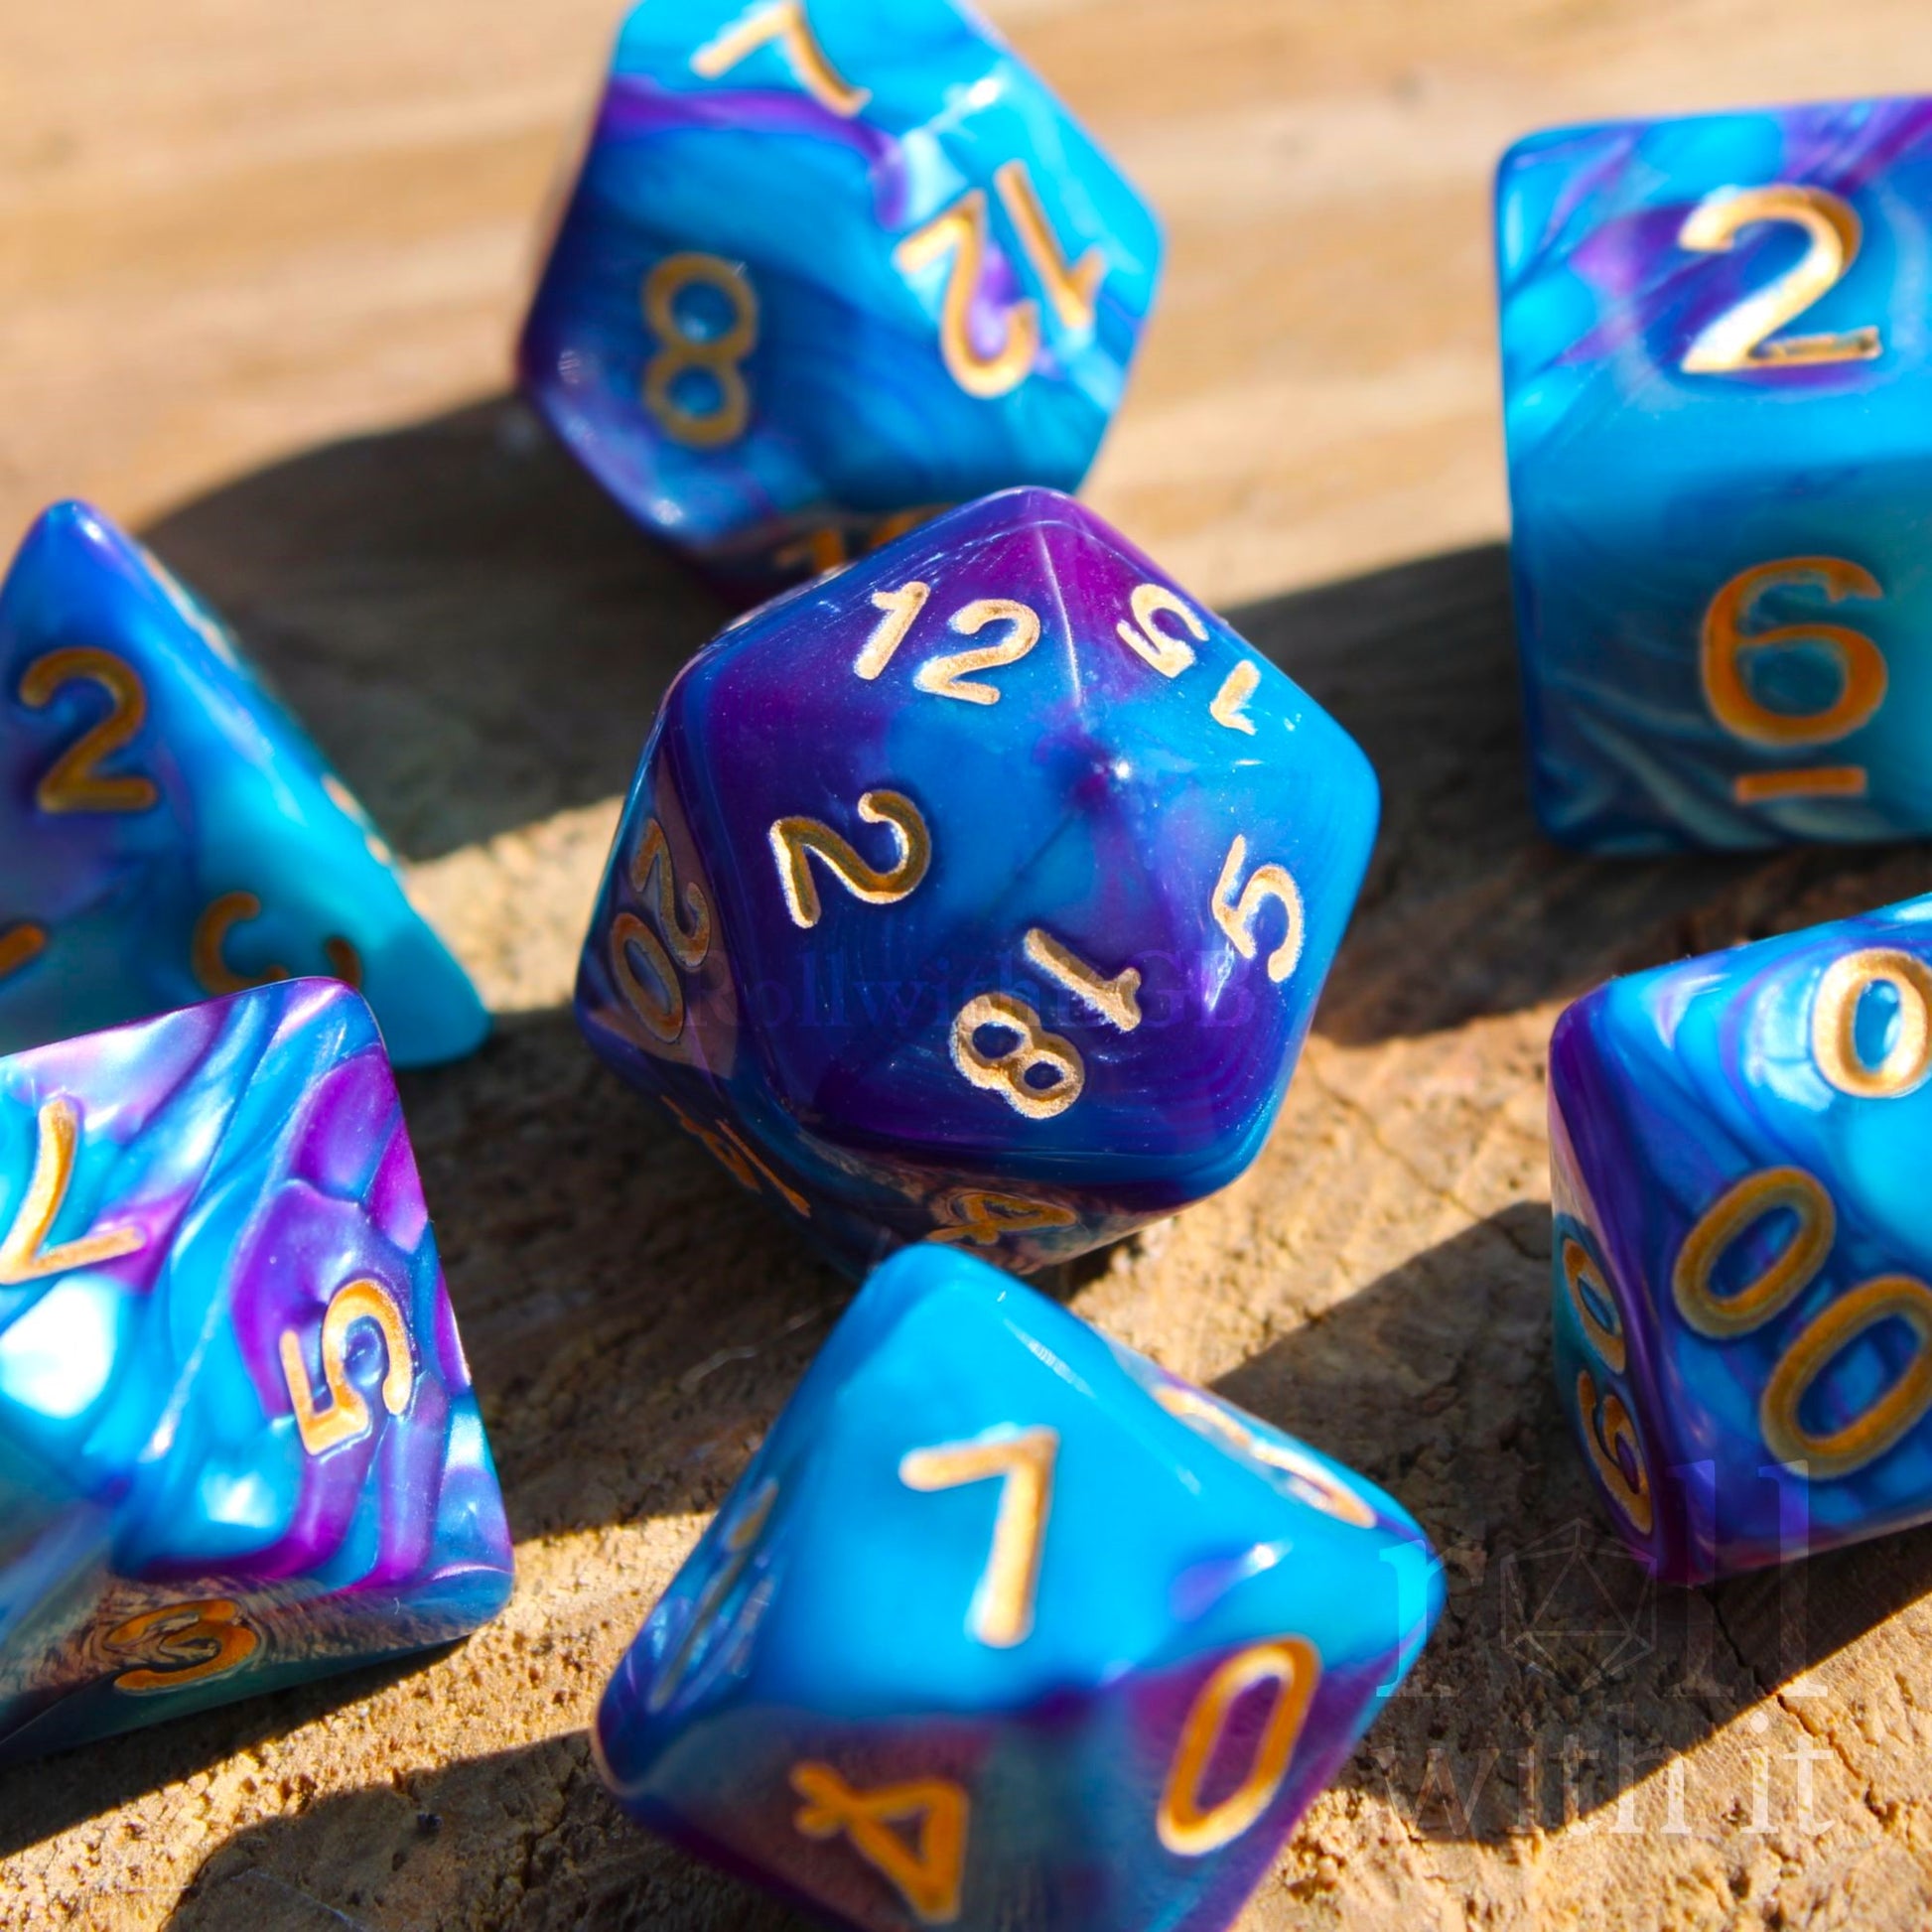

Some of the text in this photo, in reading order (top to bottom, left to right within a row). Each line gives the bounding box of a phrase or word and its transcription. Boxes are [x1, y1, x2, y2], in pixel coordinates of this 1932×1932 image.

[690, 0, 873, 116] 7
[640, 251, 758, 447] 8
[893, 160, 1110, 397] 12
[1677, 184, 1883, 372] 2
[20, 646, 156, 812] 2
[854, 581, 1040, 706] 12
[1116, 583, 1261, 736] 15
[611, 817, 710, 1041] 20
[767, 789, 932, 928] 2
[1211, 835, 1302, 982] 5
[949, 928, 1142, 1119] 18
[280, 1278, 413, 1456] 5
[899, 1423, 1059, 1649] 7
[1158, 1633, 1322, 1856] 0
[791, 1761, 968, 1923] 4
